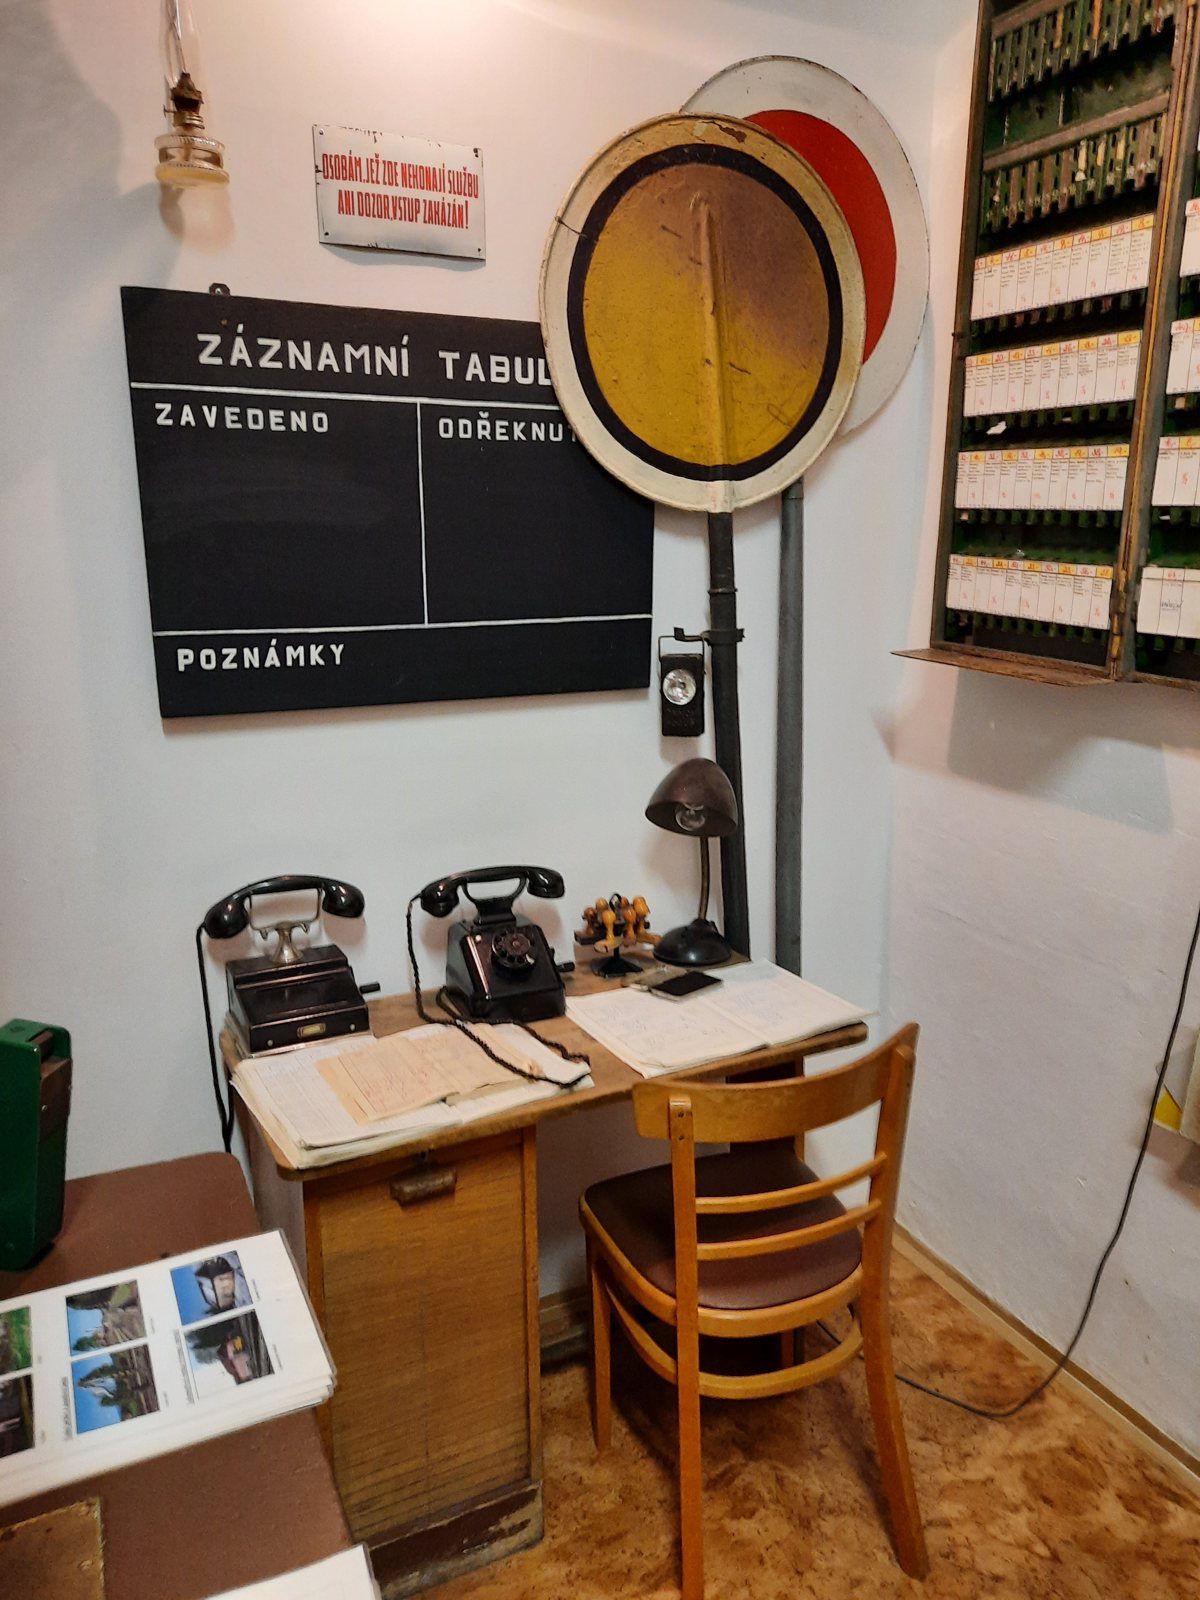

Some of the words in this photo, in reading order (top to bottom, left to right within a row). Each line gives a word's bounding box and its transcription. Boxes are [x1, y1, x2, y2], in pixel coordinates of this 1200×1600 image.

[365, 153, 380, 185] JEŽ
[382, 160, 399, 187] ZDE
[401, 163, 446, 194] NEKONAJÍ
[447, 167, 479, 199] SLUŽBU
[338, 190, 355, 216] ANI
[391, 195, 420, 223] VSTUP
[423, 197, 469, 230] ZAKÁZÁN!
[197, 323, 410, 378] ZÁZNAMNÍ
[438, 350, 552, 386] TABUL
[154, 402, 329, 433] ZAVEDENO
[177, 638, 344, 672] POZNÁMKY
